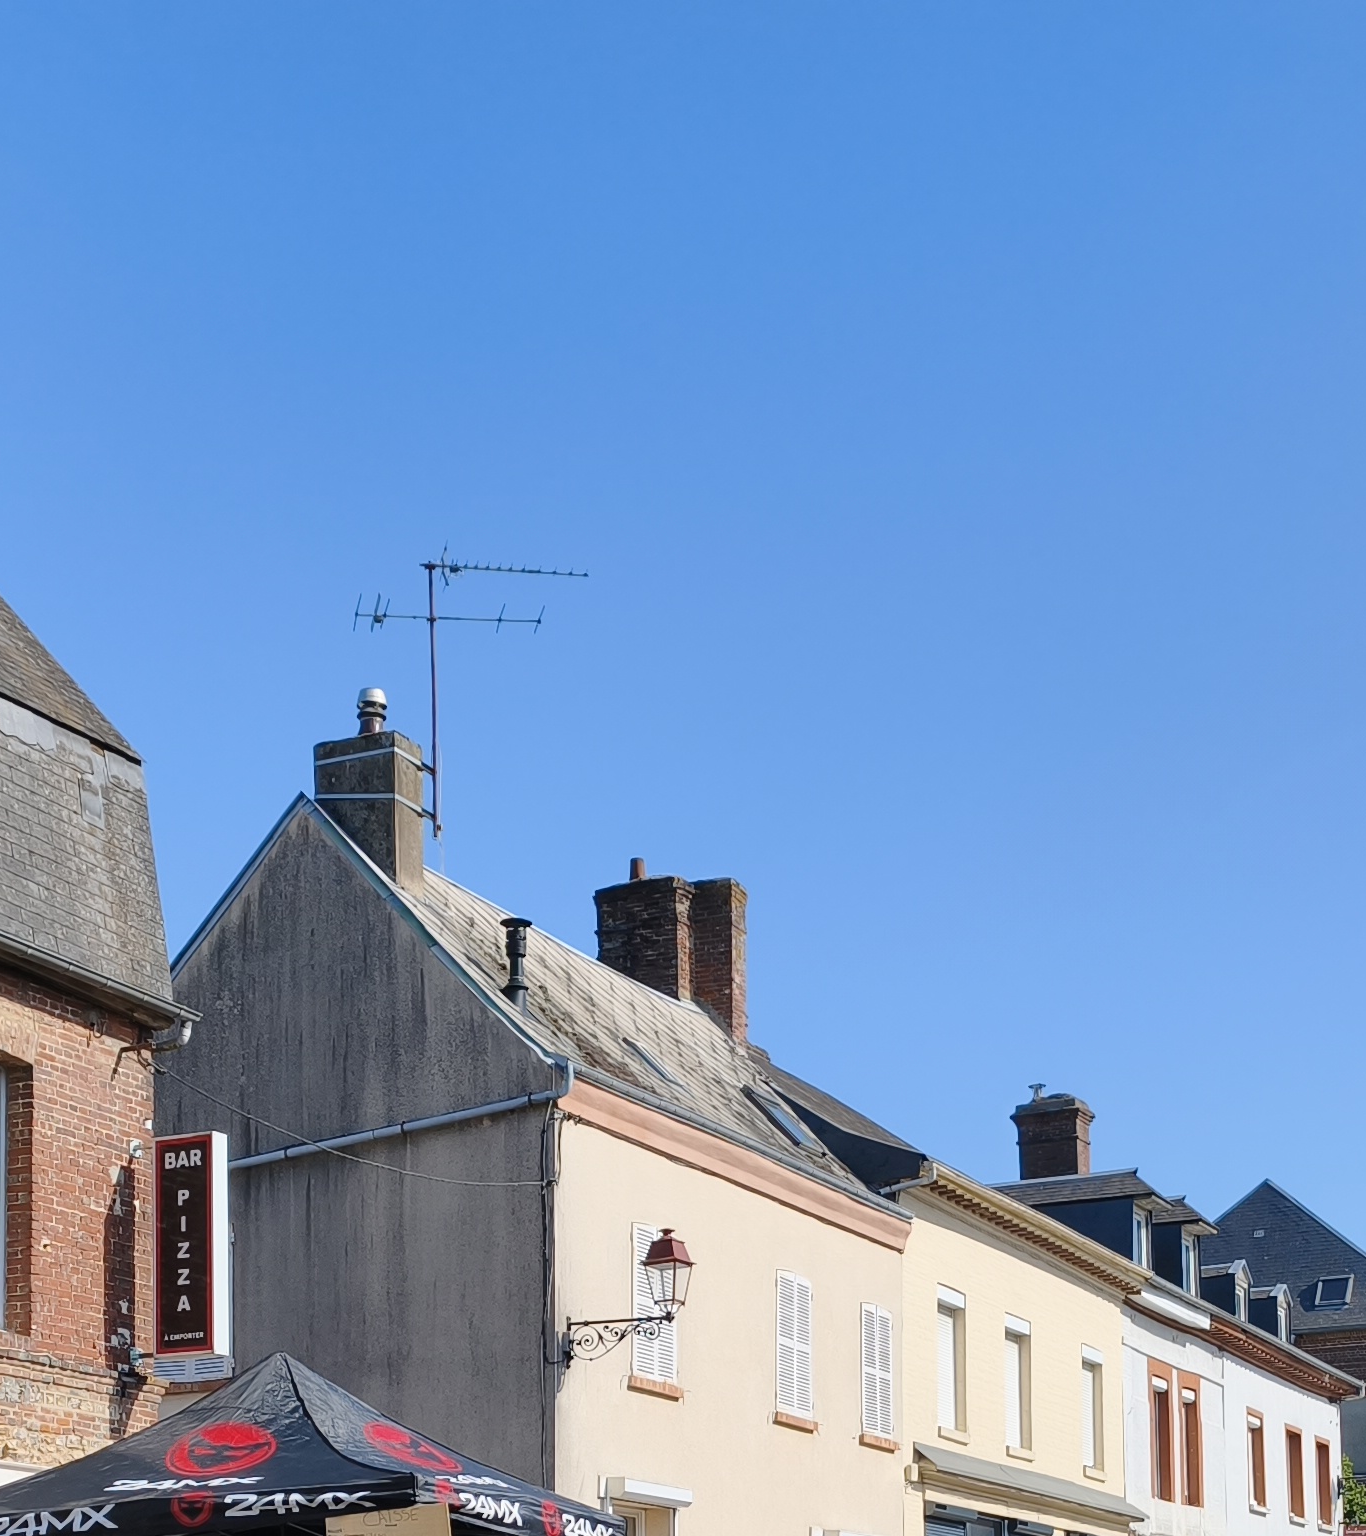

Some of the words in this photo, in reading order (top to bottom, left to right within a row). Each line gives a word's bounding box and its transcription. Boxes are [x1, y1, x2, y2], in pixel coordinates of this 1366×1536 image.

[164, 1149, 202, 1169] BAR
[176, 1189, 191, 1312] PIZZA
[170, 1331, 204, 1341] EMPORTER
[223, 1491, 377, 1517] 24MX
[458, 1493, 523, 1527] 24MX
[362, 1508, 419, 1527] CAISSE
